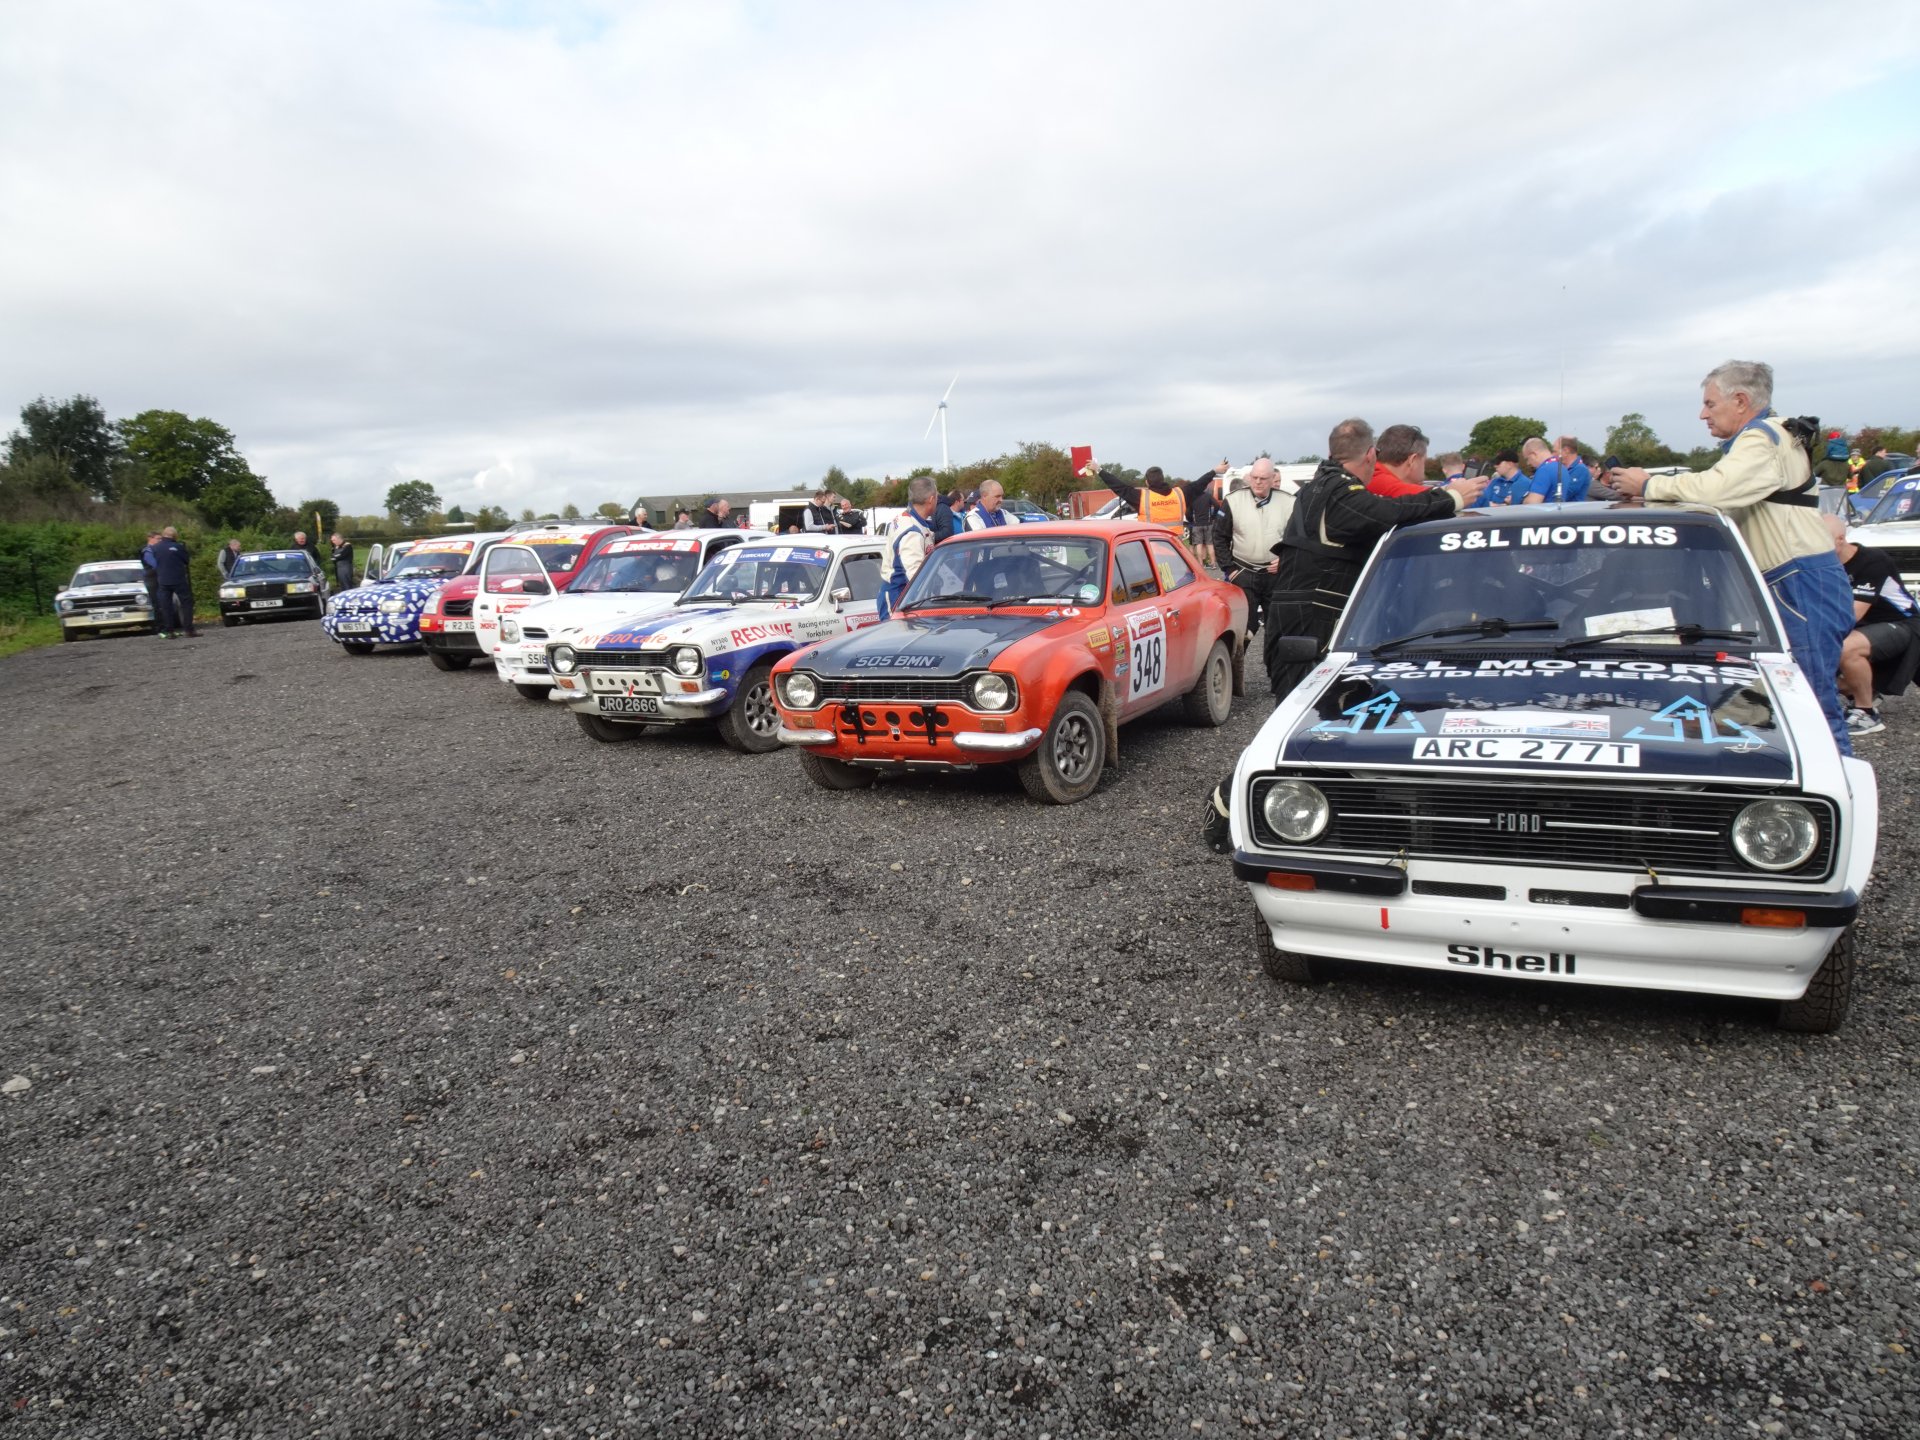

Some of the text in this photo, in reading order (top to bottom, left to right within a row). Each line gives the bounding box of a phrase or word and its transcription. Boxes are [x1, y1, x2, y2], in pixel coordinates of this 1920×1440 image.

[1440, 526, 1678, 551] S&L MOTORS
[452, 622, 463, 630] R2
[798, 618, 840, 629] Racing engines
[806, 629, 832, 637] Yorkshire
[579, 633, 668, 645] NY500 cafe
[731, 622, 794, 647] REDLINE
[894, 656, 936, 666] BMN
[1133, 636, 1161, 693] 348
[1339, 659, 1761, 679] S&L MOTORS
[1341, 669, 1564, 682] ACCIDENT
[1580, 670, 1755, 687] REPAIR
[600, 698, 657, 712] JRO 266G
[1421, 739, 1633, 764] ARC 277T
[1497, 812, 1541, 833] FORD
[1447, 944, 1576, 975] Shell
